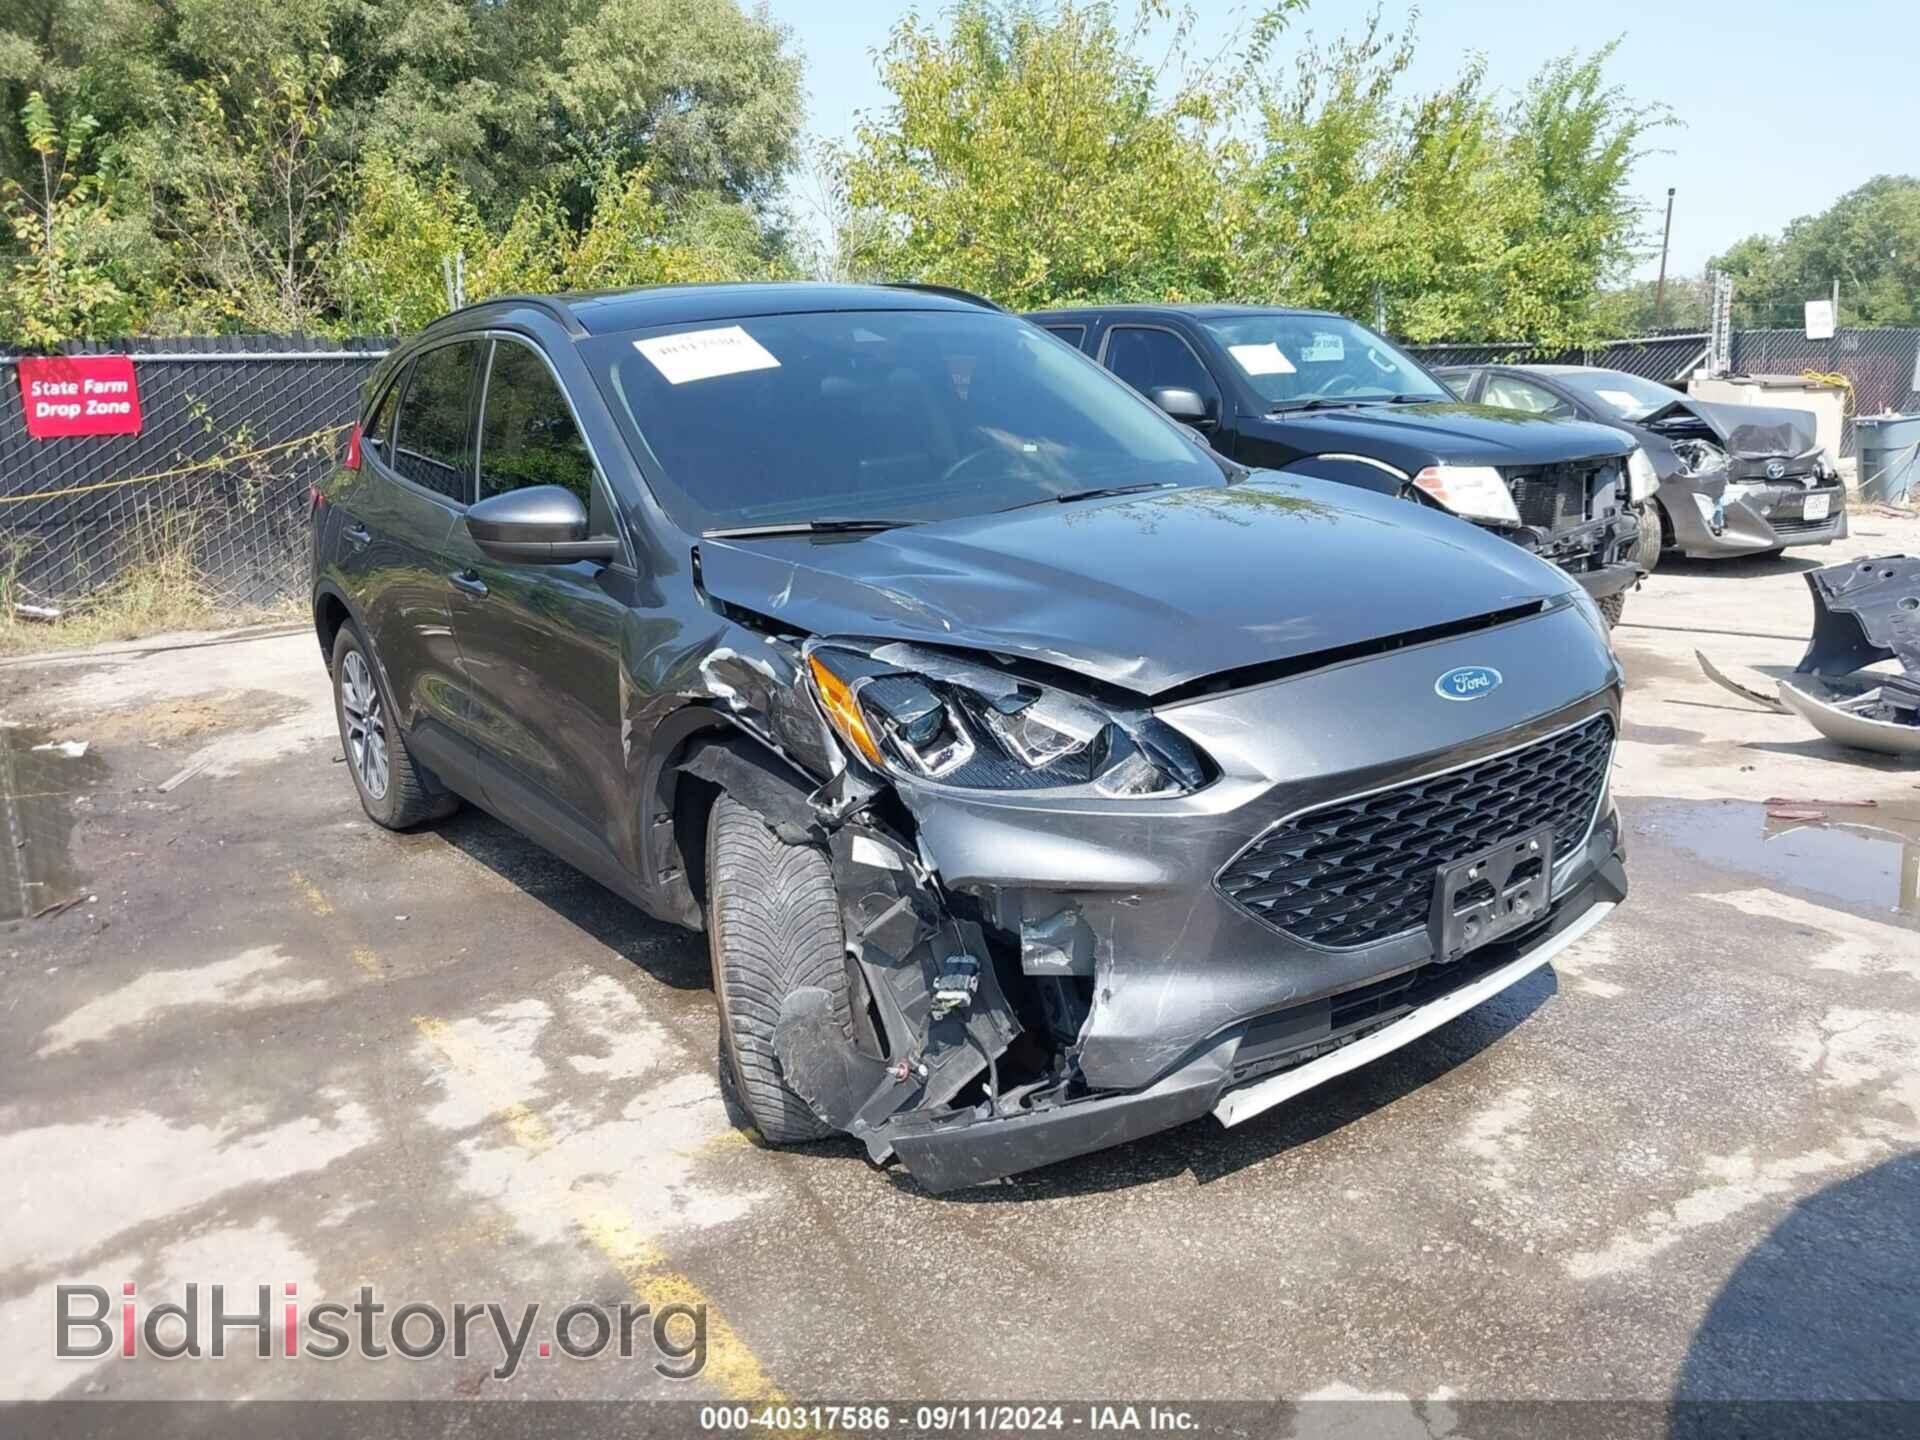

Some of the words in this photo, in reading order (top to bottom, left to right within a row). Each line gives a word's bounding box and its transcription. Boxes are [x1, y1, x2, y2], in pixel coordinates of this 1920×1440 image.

[31, 380, 78, 396] State
[84, 379, 128, 394] Farm
[36, 401, 81, 419] Drop
[86, 400, 131, 415] Zone
[1453, 672, 1490, 693] Ford
